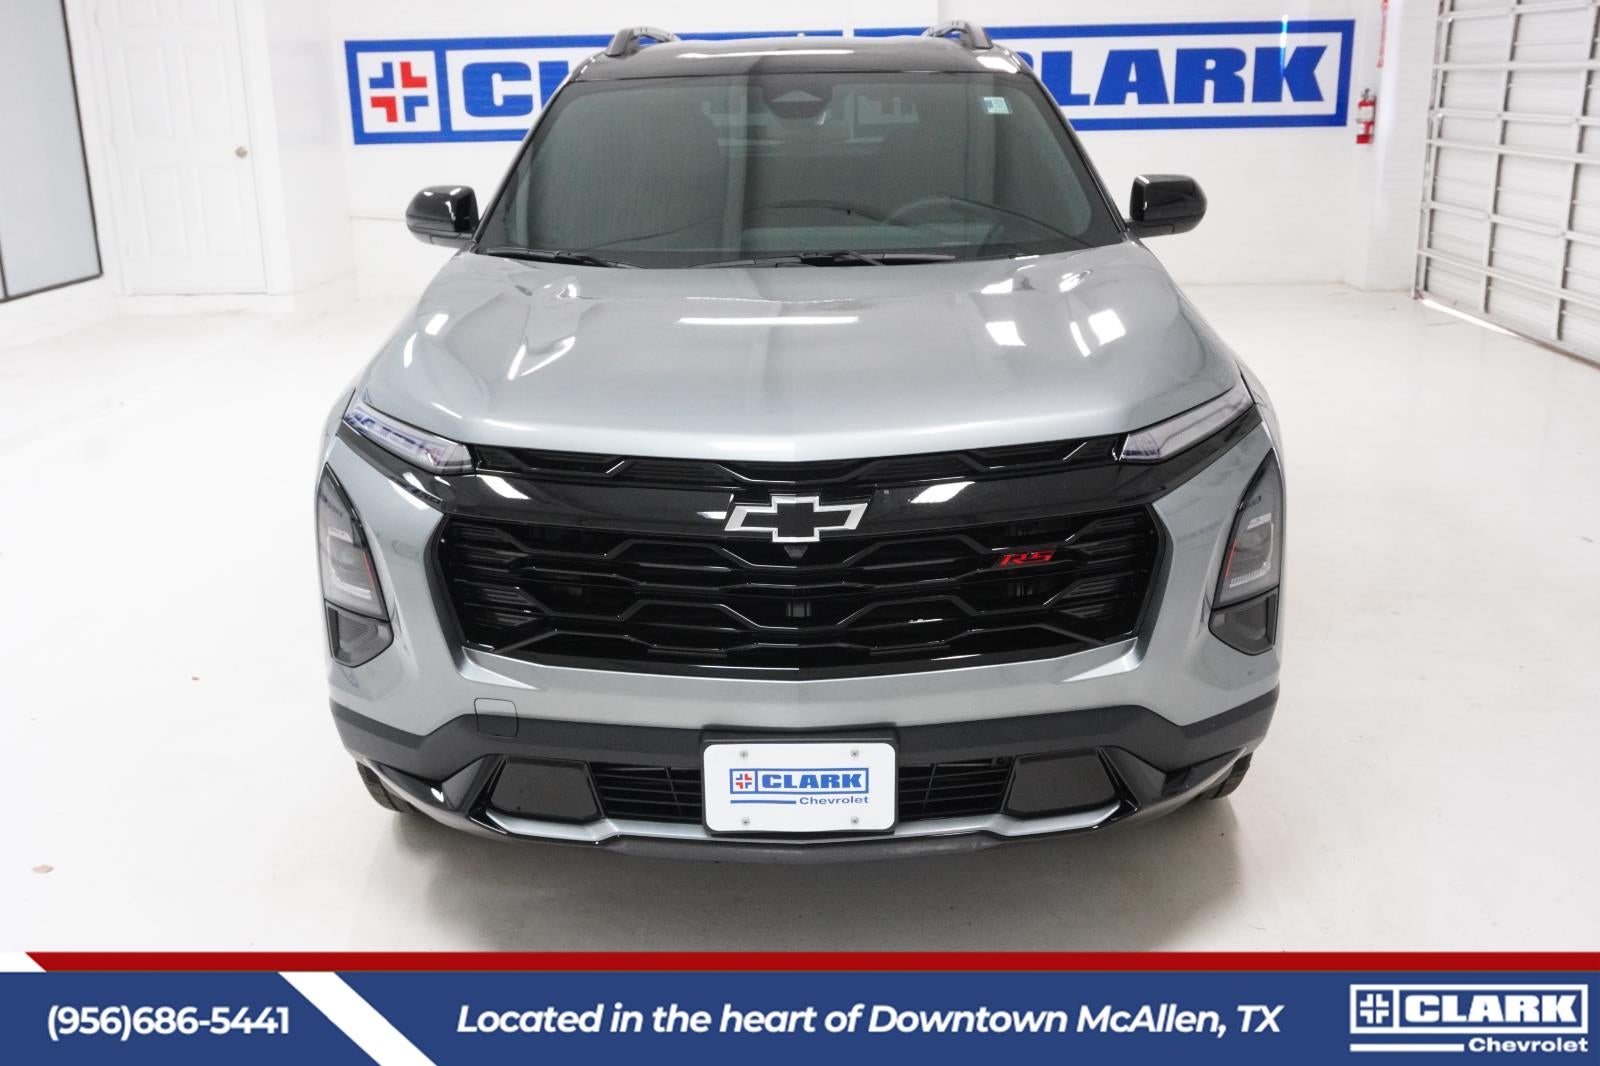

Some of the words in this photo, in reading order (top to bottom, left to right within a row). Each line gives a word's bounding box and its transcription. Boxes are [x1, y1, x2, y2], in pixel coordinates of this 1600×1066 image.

[1016, 45, 1328, 106] LARK
[1000, 550, 1056, 567] RS
[761, 773, 862, 789] CLARK
[799, 795, 869, 805] Chevrolet
